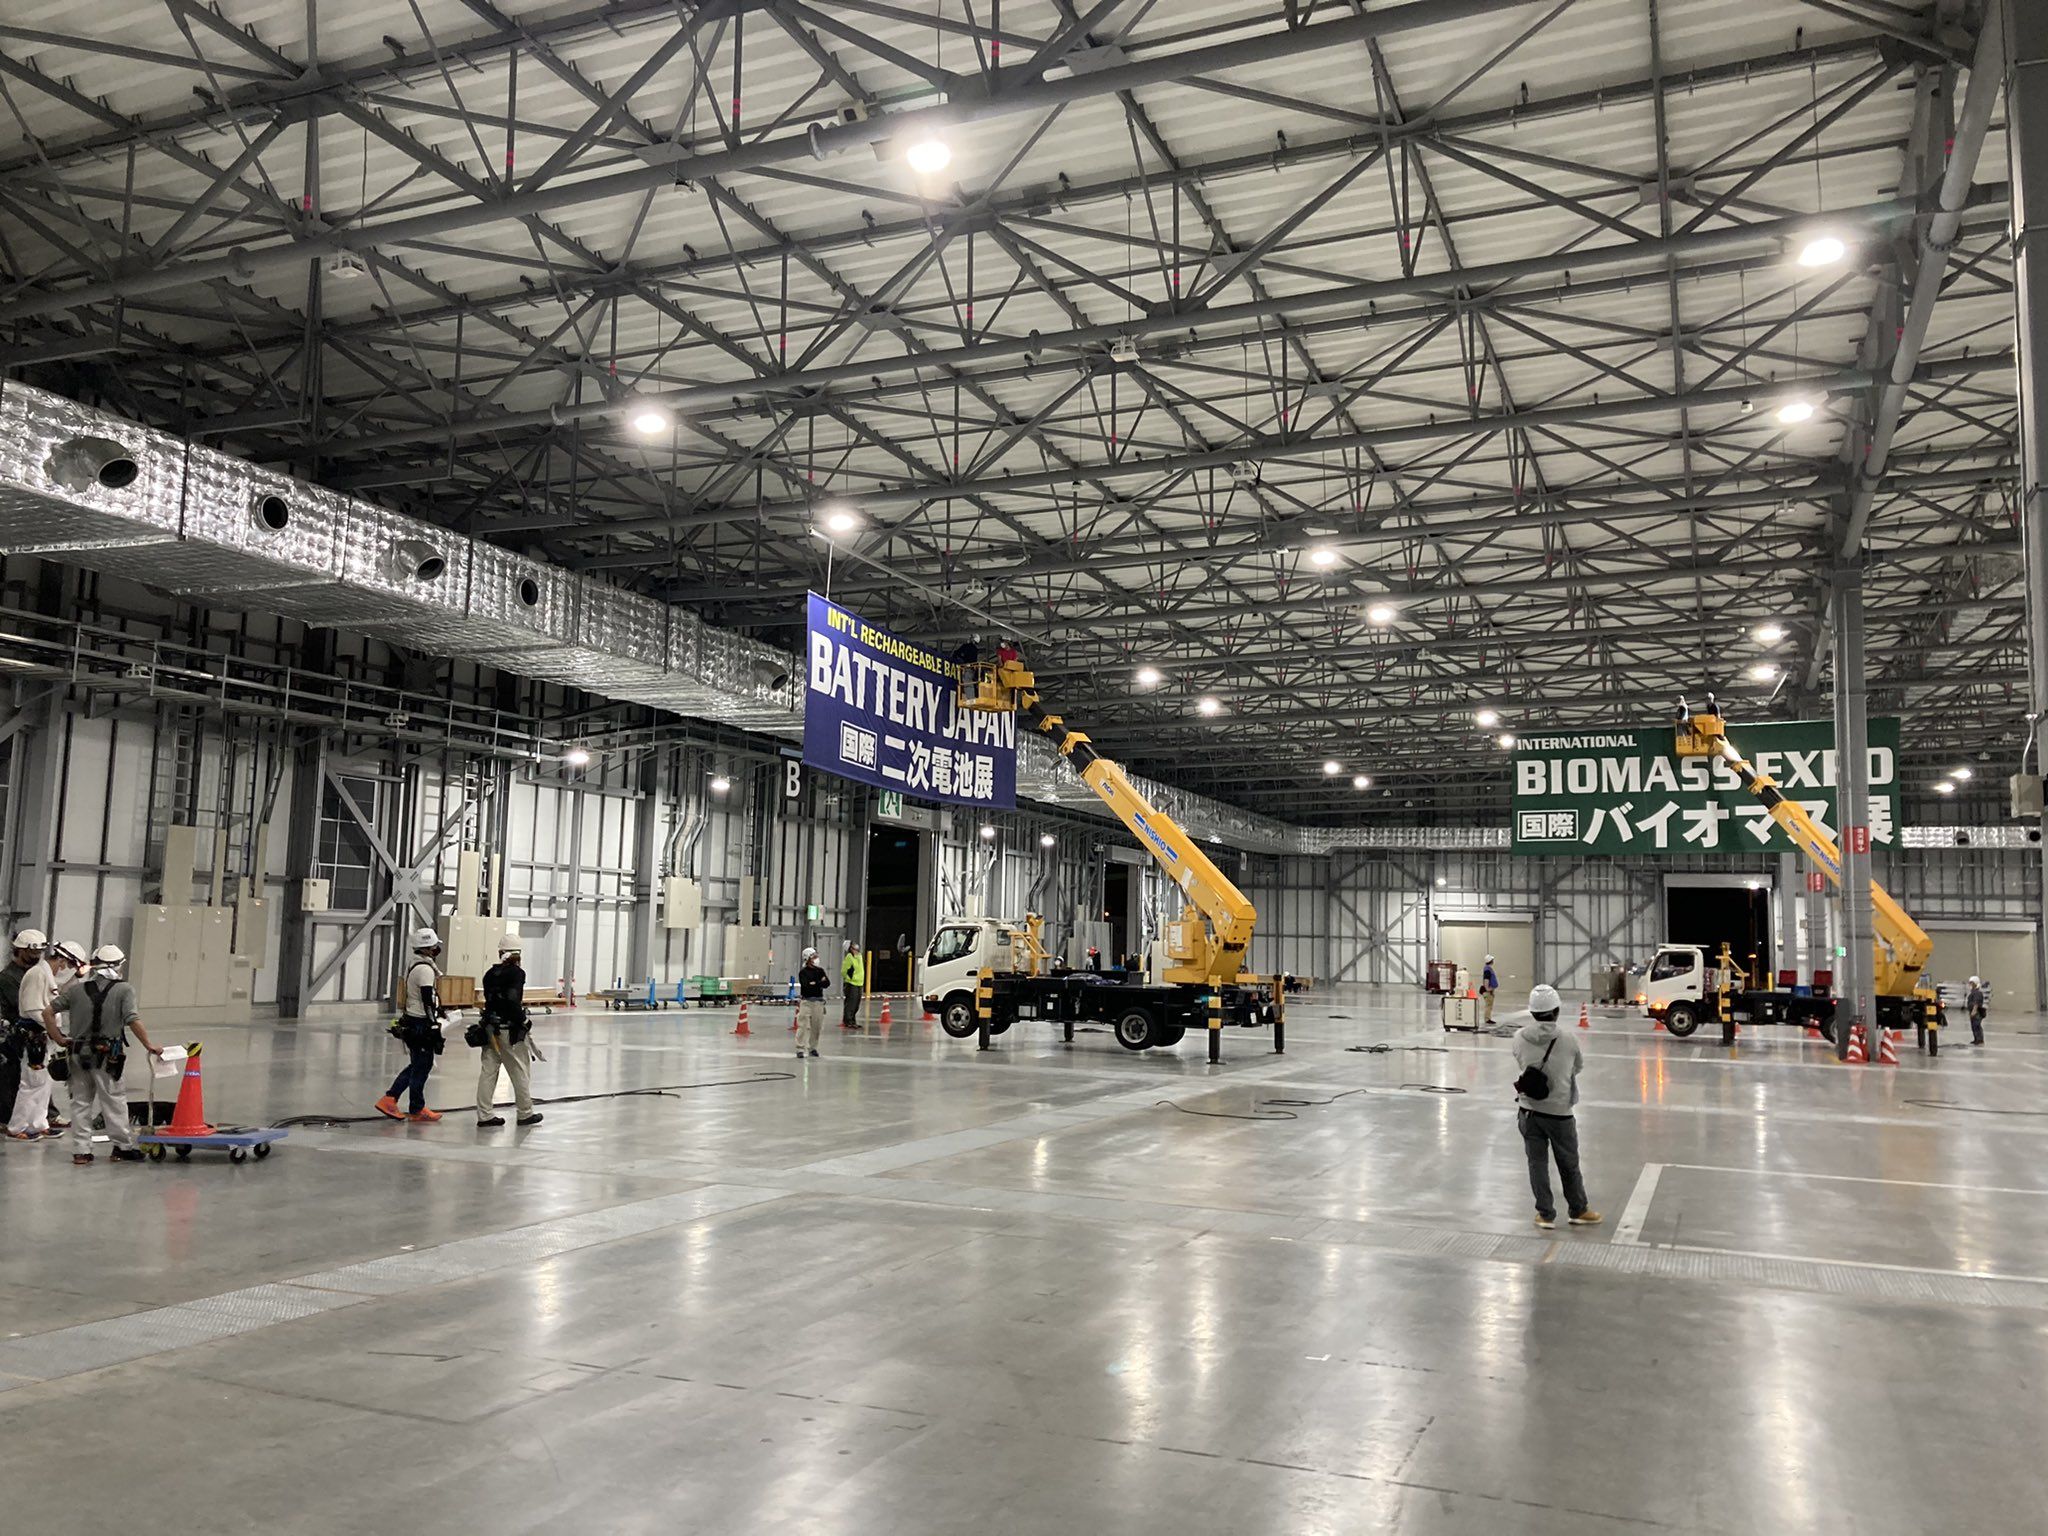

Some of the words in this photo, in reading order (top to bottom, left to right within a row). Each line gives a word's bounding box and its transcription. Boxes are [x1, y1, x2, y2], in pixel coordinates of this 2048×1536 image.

[828, 606, 859, 639] INT'L
[861, 624, 942, 675] RECHARGEABLE
[810, 630, 943, 735] BATTERY
[942, 689, 1016, 750] JAPAN
[1517, 735, 1638, 751] INTERNATIONAL
[786, 760, 801, 798] B
[882, 734, 994, 801] 二次電池展
[1516, 754, 1742, 796] BIOMASS
[1144, 823, 1167, 851] NISHIO
[1521, 812, 1575, 839] 国際
